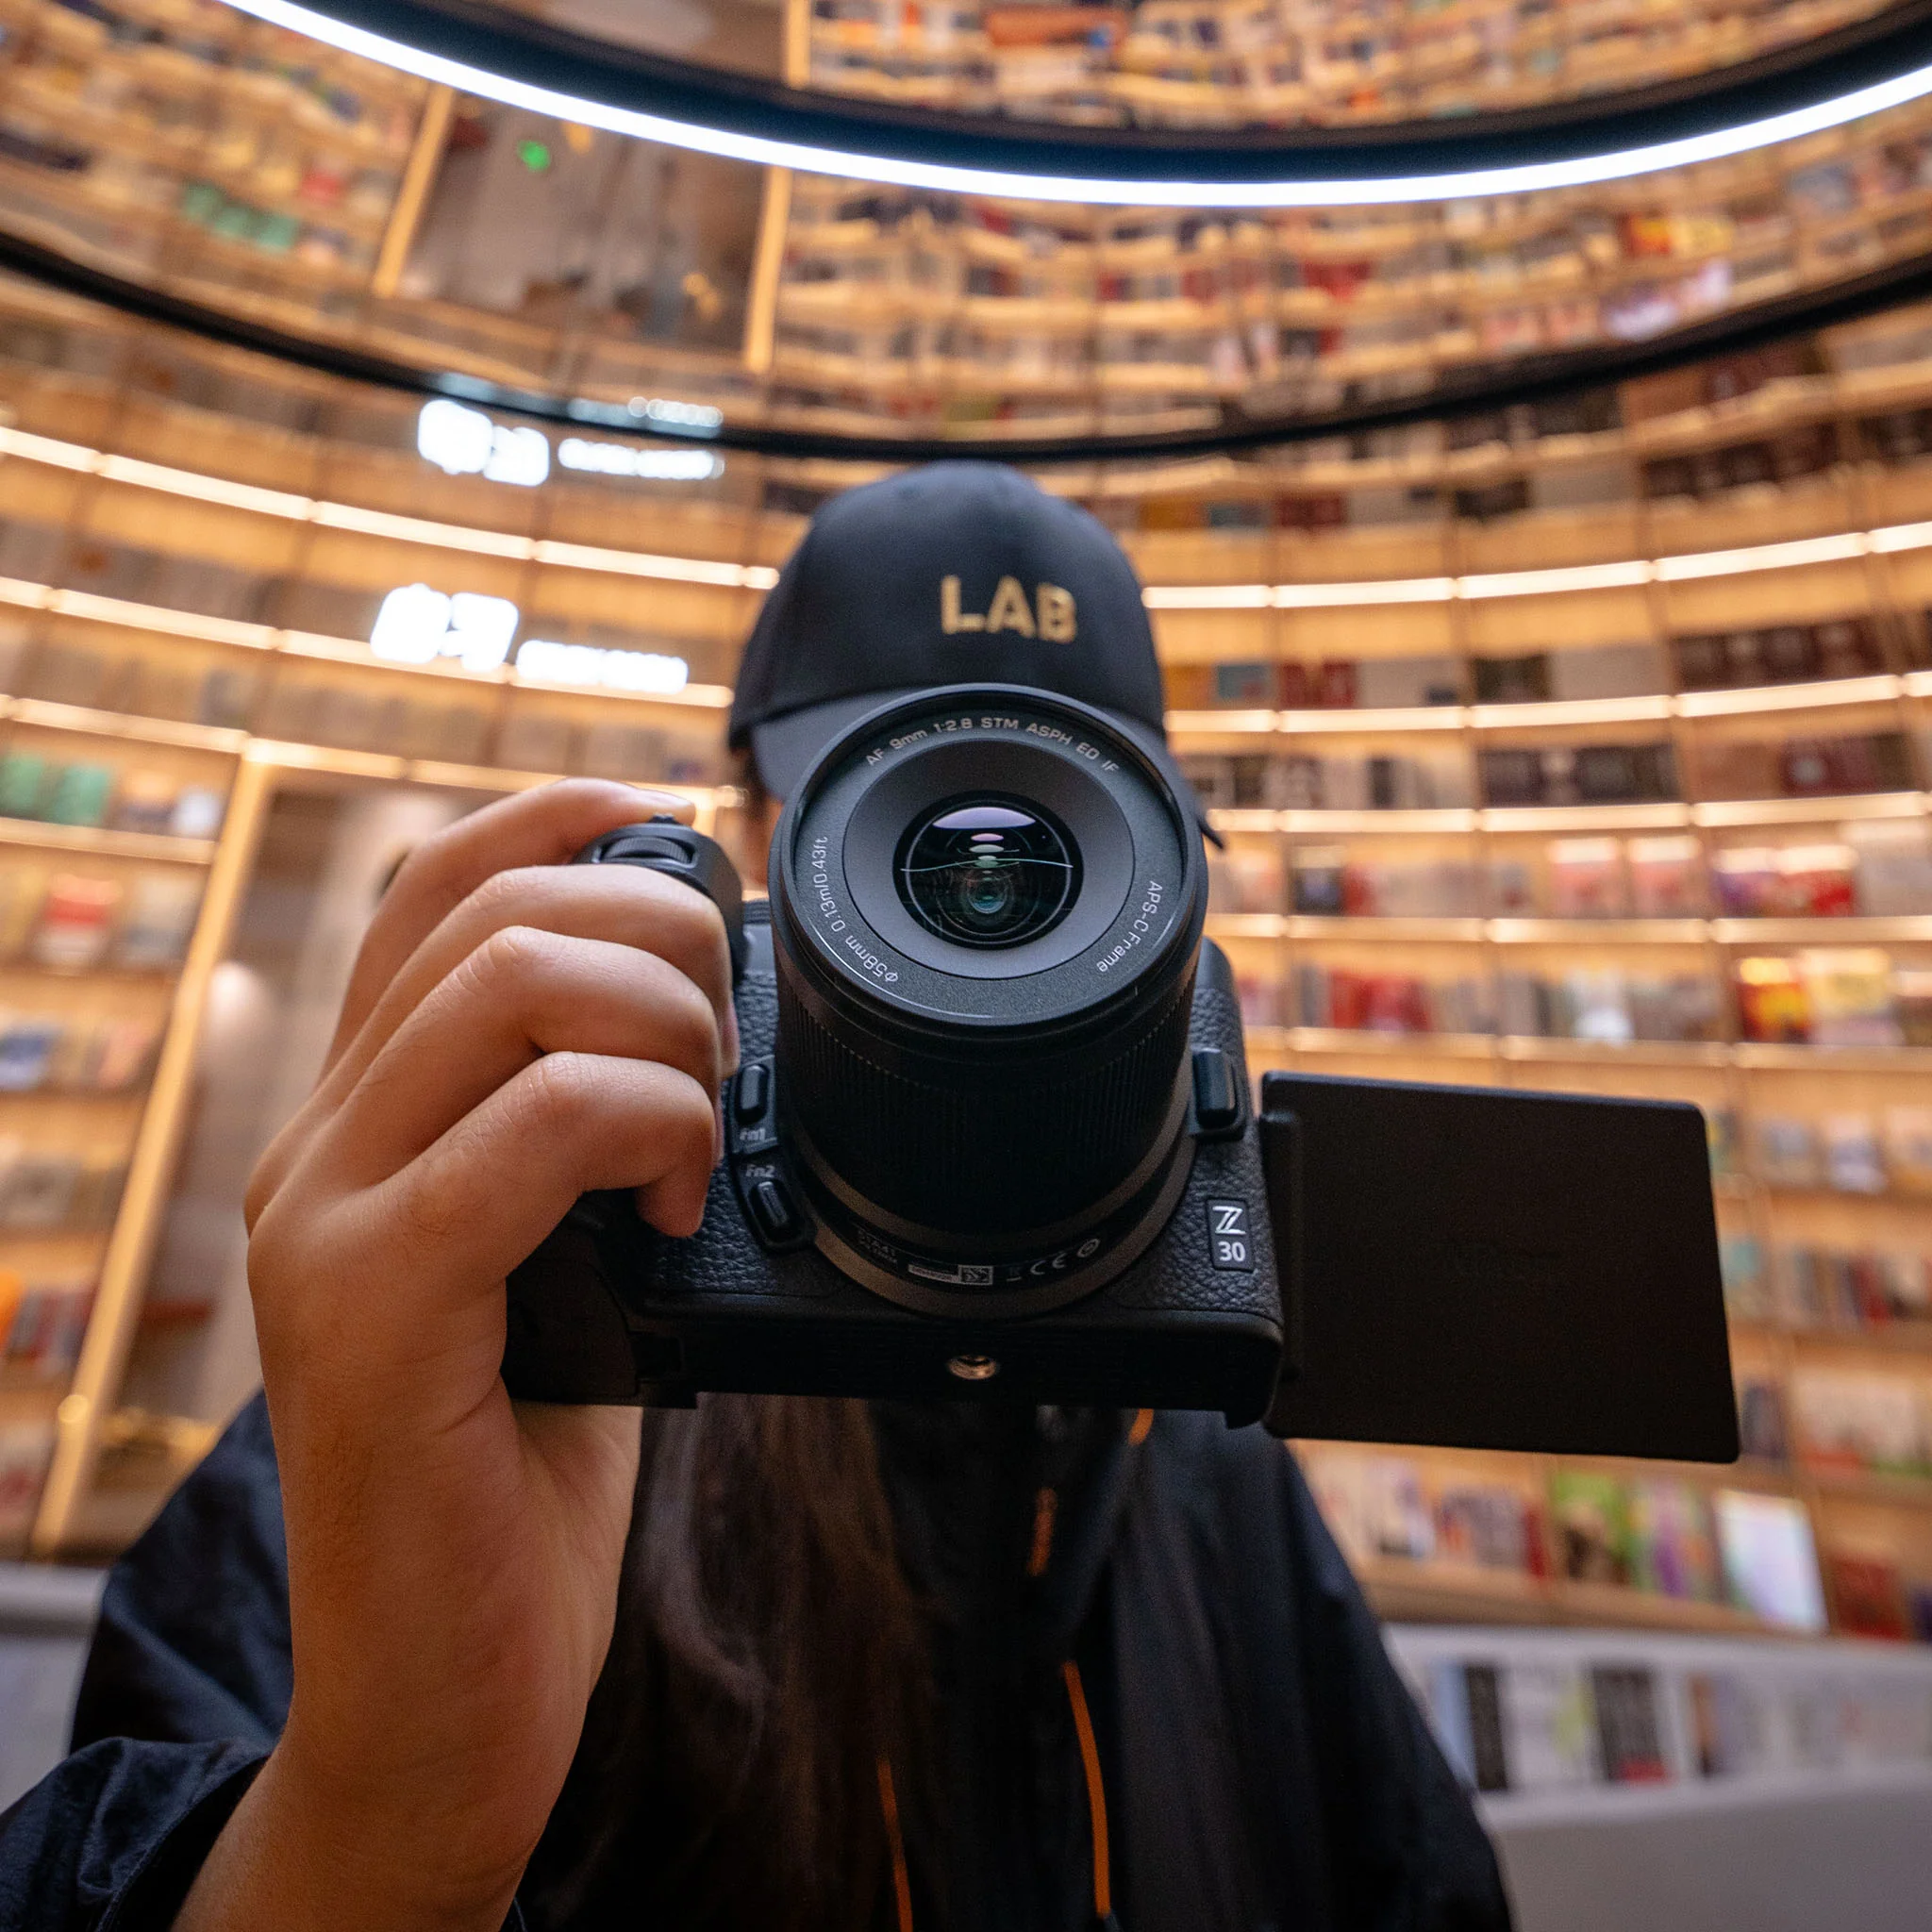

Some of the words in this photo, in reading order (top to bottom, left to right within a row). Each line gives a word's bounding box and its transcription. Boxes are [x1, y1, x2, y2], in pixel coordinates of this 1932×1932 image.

[941, 575, 1077, 644] LAB
[866, 747, 885, 766] AF
[889, 729, 927, 750] 9mm
[981, 717, 1019, 729] STM
[1025, 723, 1073, 745] ASPH
[1075, 742, 1100, 760] ED
[1101, 759, 1120, 773] IF
[1132, 880, 1163, 932] APS-C
[1096, 931, 1141, 972] Frame
[1212, 1206, 1246, 1235] Z
[1218, 1241, 1246, 1262] 30
